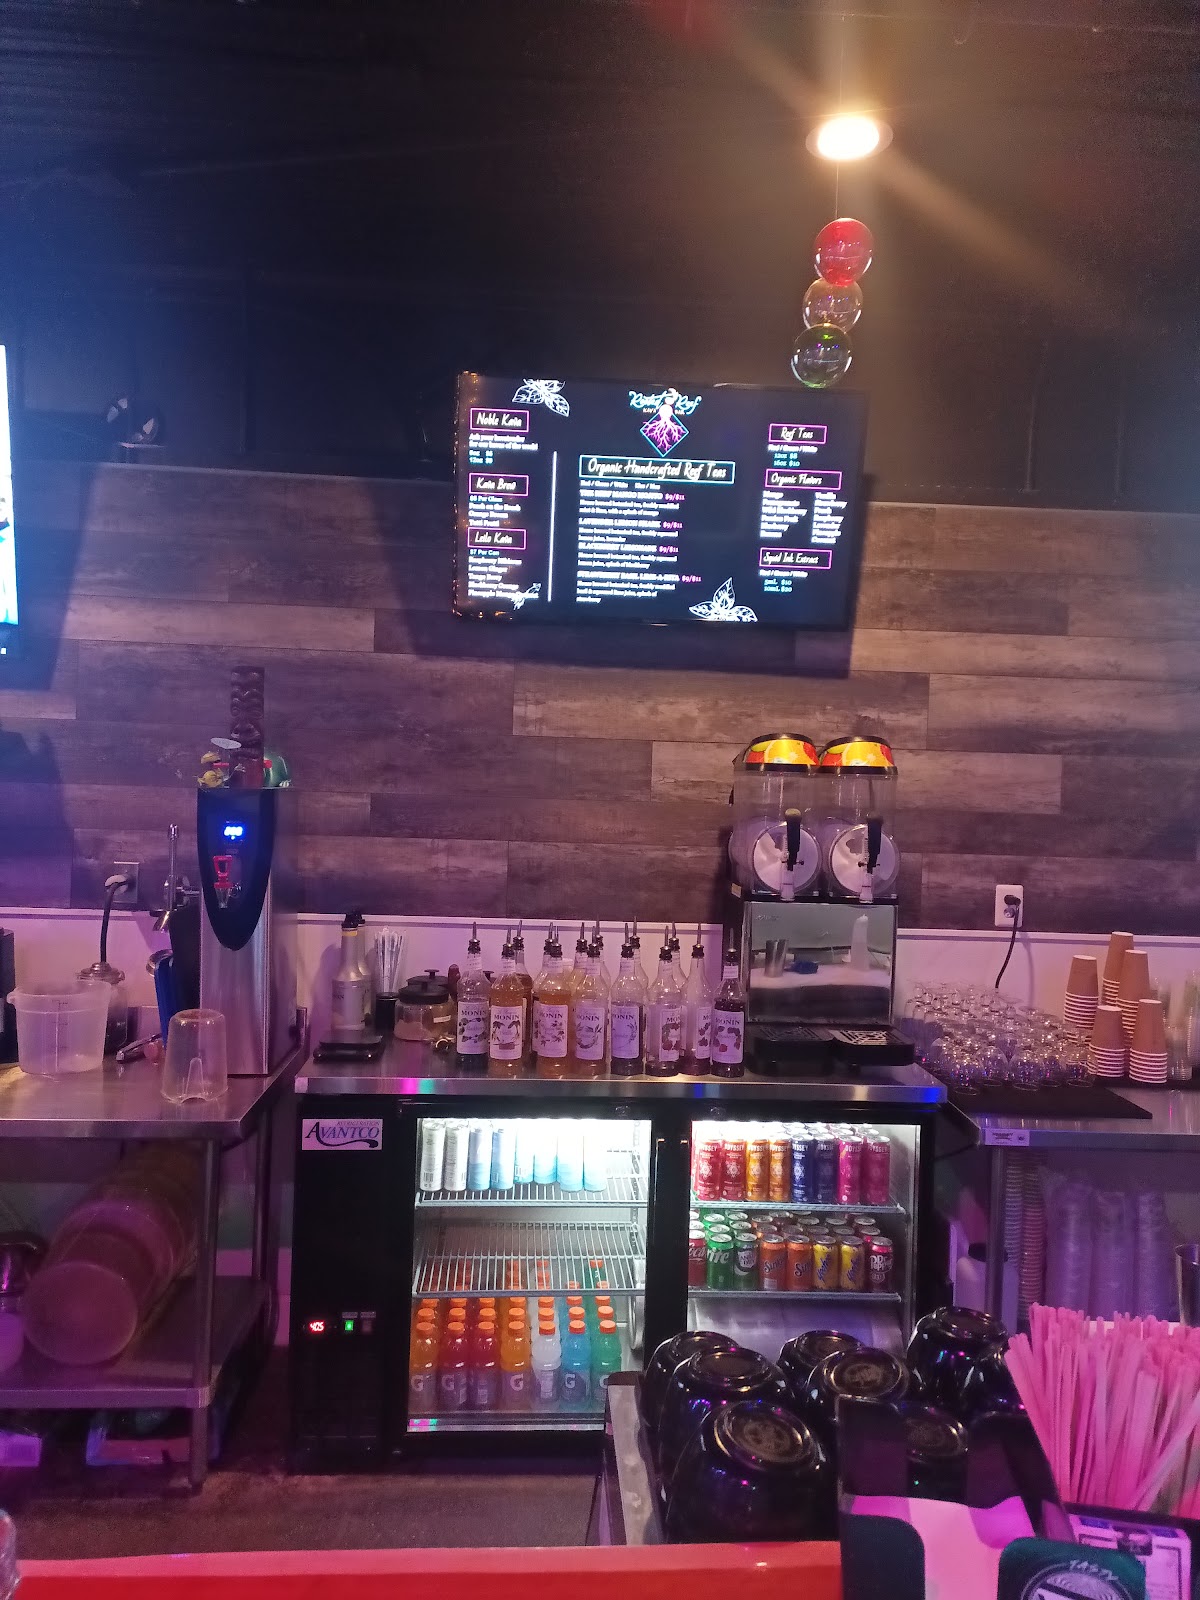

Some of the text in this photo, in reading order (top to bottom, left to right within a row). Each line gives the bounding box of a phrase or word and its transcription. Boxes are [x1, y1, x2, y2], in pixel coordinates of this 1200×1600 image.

[476, 412, 522, 426] Noble Kava
[781, 427, 814, 442] Reef Teas
[588, 458, 726, 480] Organic Handcrafted Reef Teas
[476, 477, 516, 490] Kava Brew
[771, 472, 822, 486] Organic Flavors
[474, 531, 512, 544] Leilo Kava
[796, 553, 819, 564] Extract
[305, 1122, 380, 1147] AVANTCO
[411, 1374, 424, 1391] G
[442, 1374, 454, 1390] G
[510, 1374, 524, 1391] G
[565, 1374, 576, 1388] G
